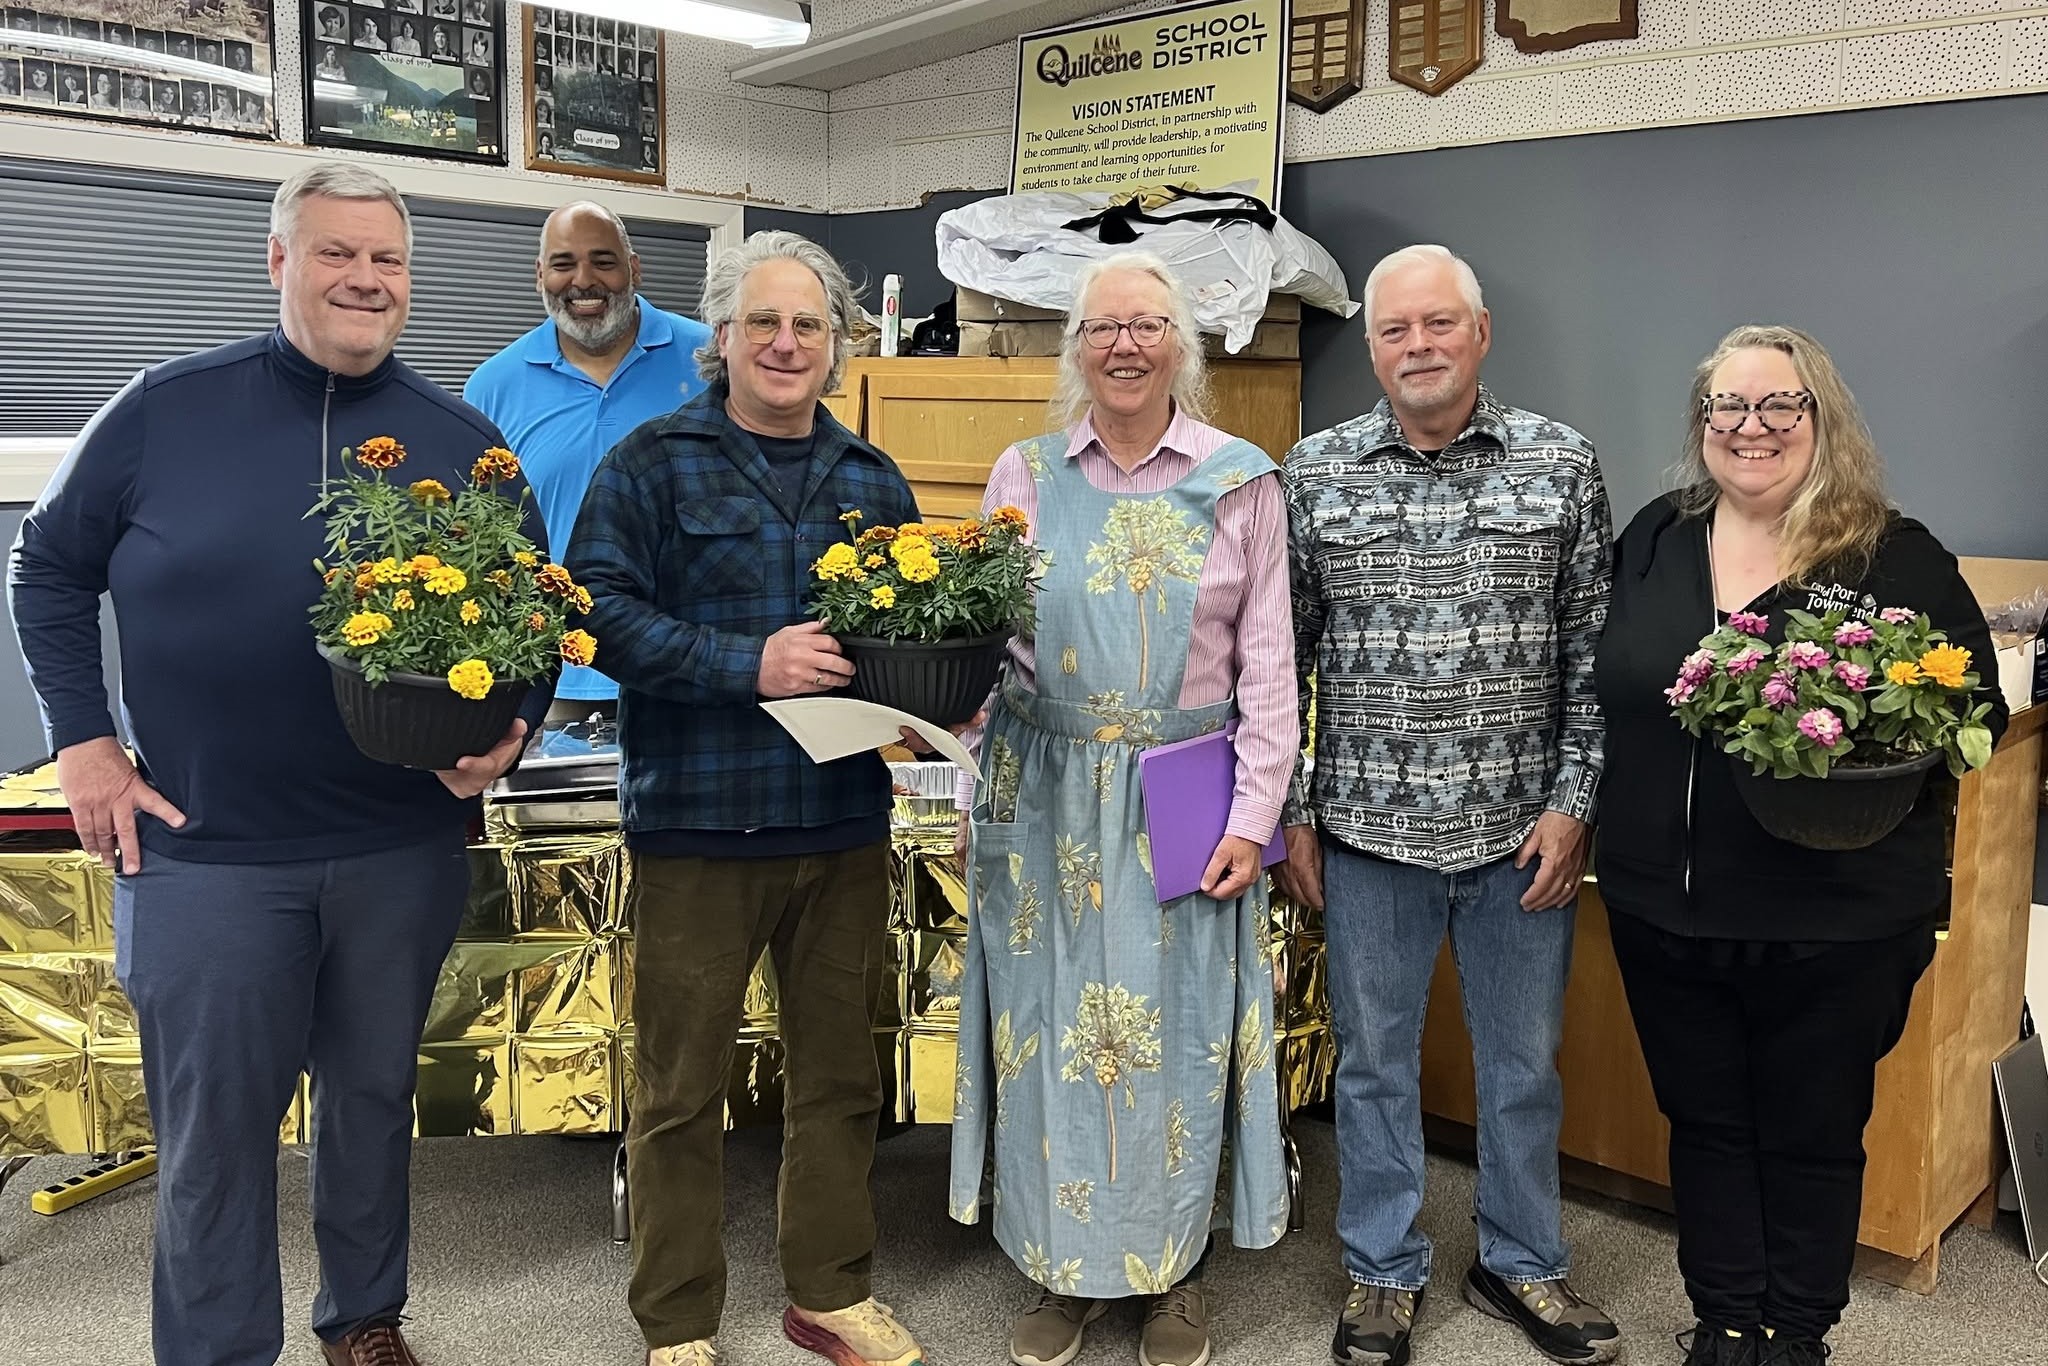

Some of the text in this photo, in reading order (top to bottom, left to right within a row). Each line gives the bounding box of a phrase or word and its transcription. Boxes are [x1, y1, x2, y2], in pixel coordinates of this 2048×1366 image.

[1156, 12, 1265, 47] SCHOOL
[1037, 44, 1143, 87] Quilcene
[1153, 33, 1268, 69] DISTRICT
[1072, 85, 1216, 120] VISION STATEMENT
[1024, 119, 1268, 159] the community, will provide leadership, a motivating
[1025, 101, 1257, 142] The Quilcene School District, in partnership with
[1022, 141, 1225, 175] environment and learning opportunities for
[1020, 163, 1200, 191] students to take charge of their future.
